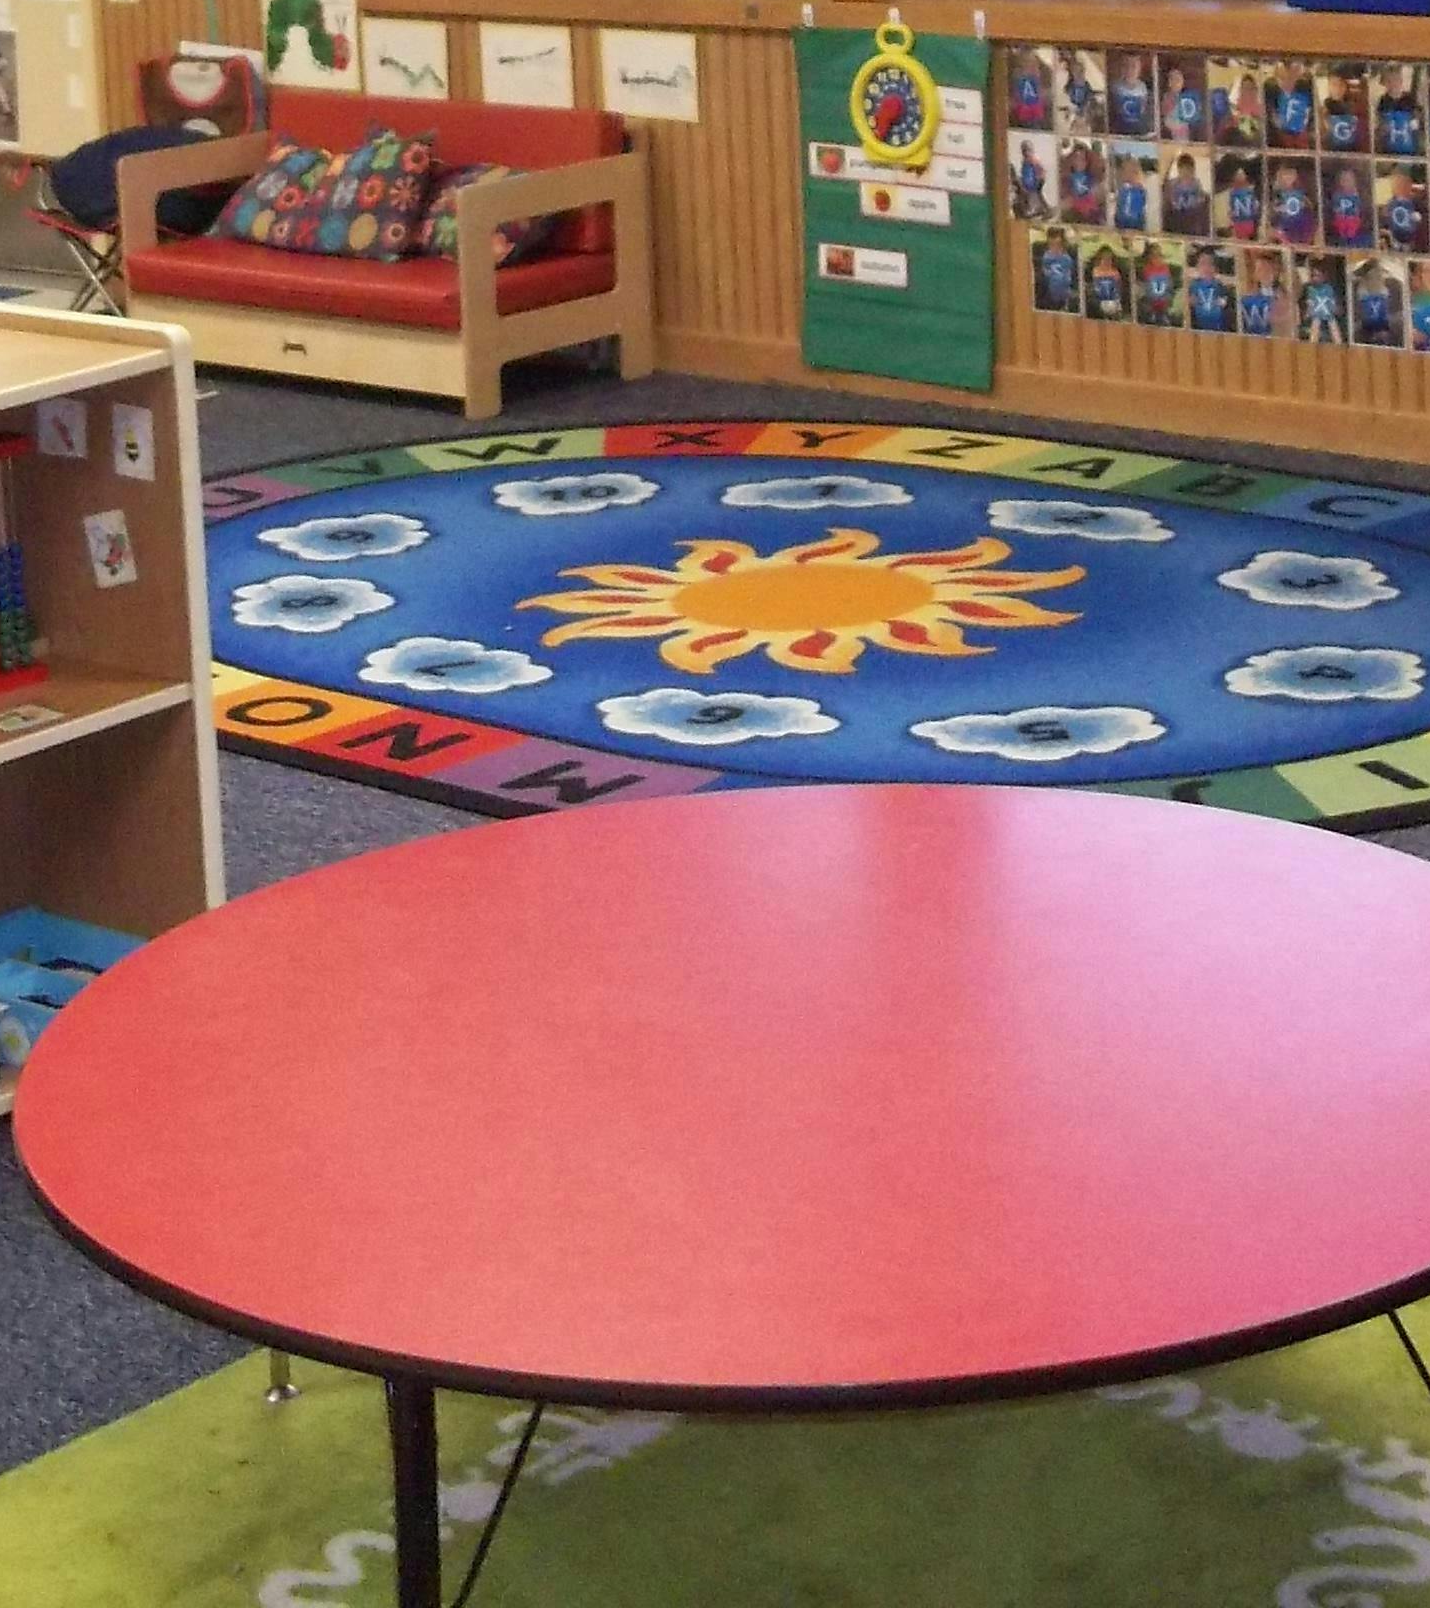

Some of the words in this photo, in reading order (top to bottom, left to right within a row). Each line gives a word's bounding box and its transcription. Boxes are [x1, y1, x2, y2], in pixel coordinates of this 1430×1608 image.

[1180, 97, 1196, 119] D
[1285, 99, 1300, 122] F
[1333, 121, 1353, 141] G
[1389, 119, 1410, 143] H
[1233, 198, 1253, 216] N
[1286, 197, 1301, 216] O
[1392, 205, 1411, 228] Q
[1313, 295, 1330, 313] X
[1242, 302, 1270, 331] W
[442, 436, 563, 461] W
[656, 428, 723, 451] X
[792, 429, 859, 449] Y
[918, 437, 1002, 460] Z
[1032, 454, 1115, 481] A
[542, 481, 620, 502] 10
[1176, 470, 1255, 498] B
[1308, 493, 1399, 522] C
[1282, 570, 1336, 591] 3
[280, 592, 338, 610] 8
[1298, 662, 1355, 683] 4
[225, 696, 333, 728] O
[338, 722, 471, 762] N
[1016, 718, 1071, 743] 5
[500, 760, 646, 804] M
